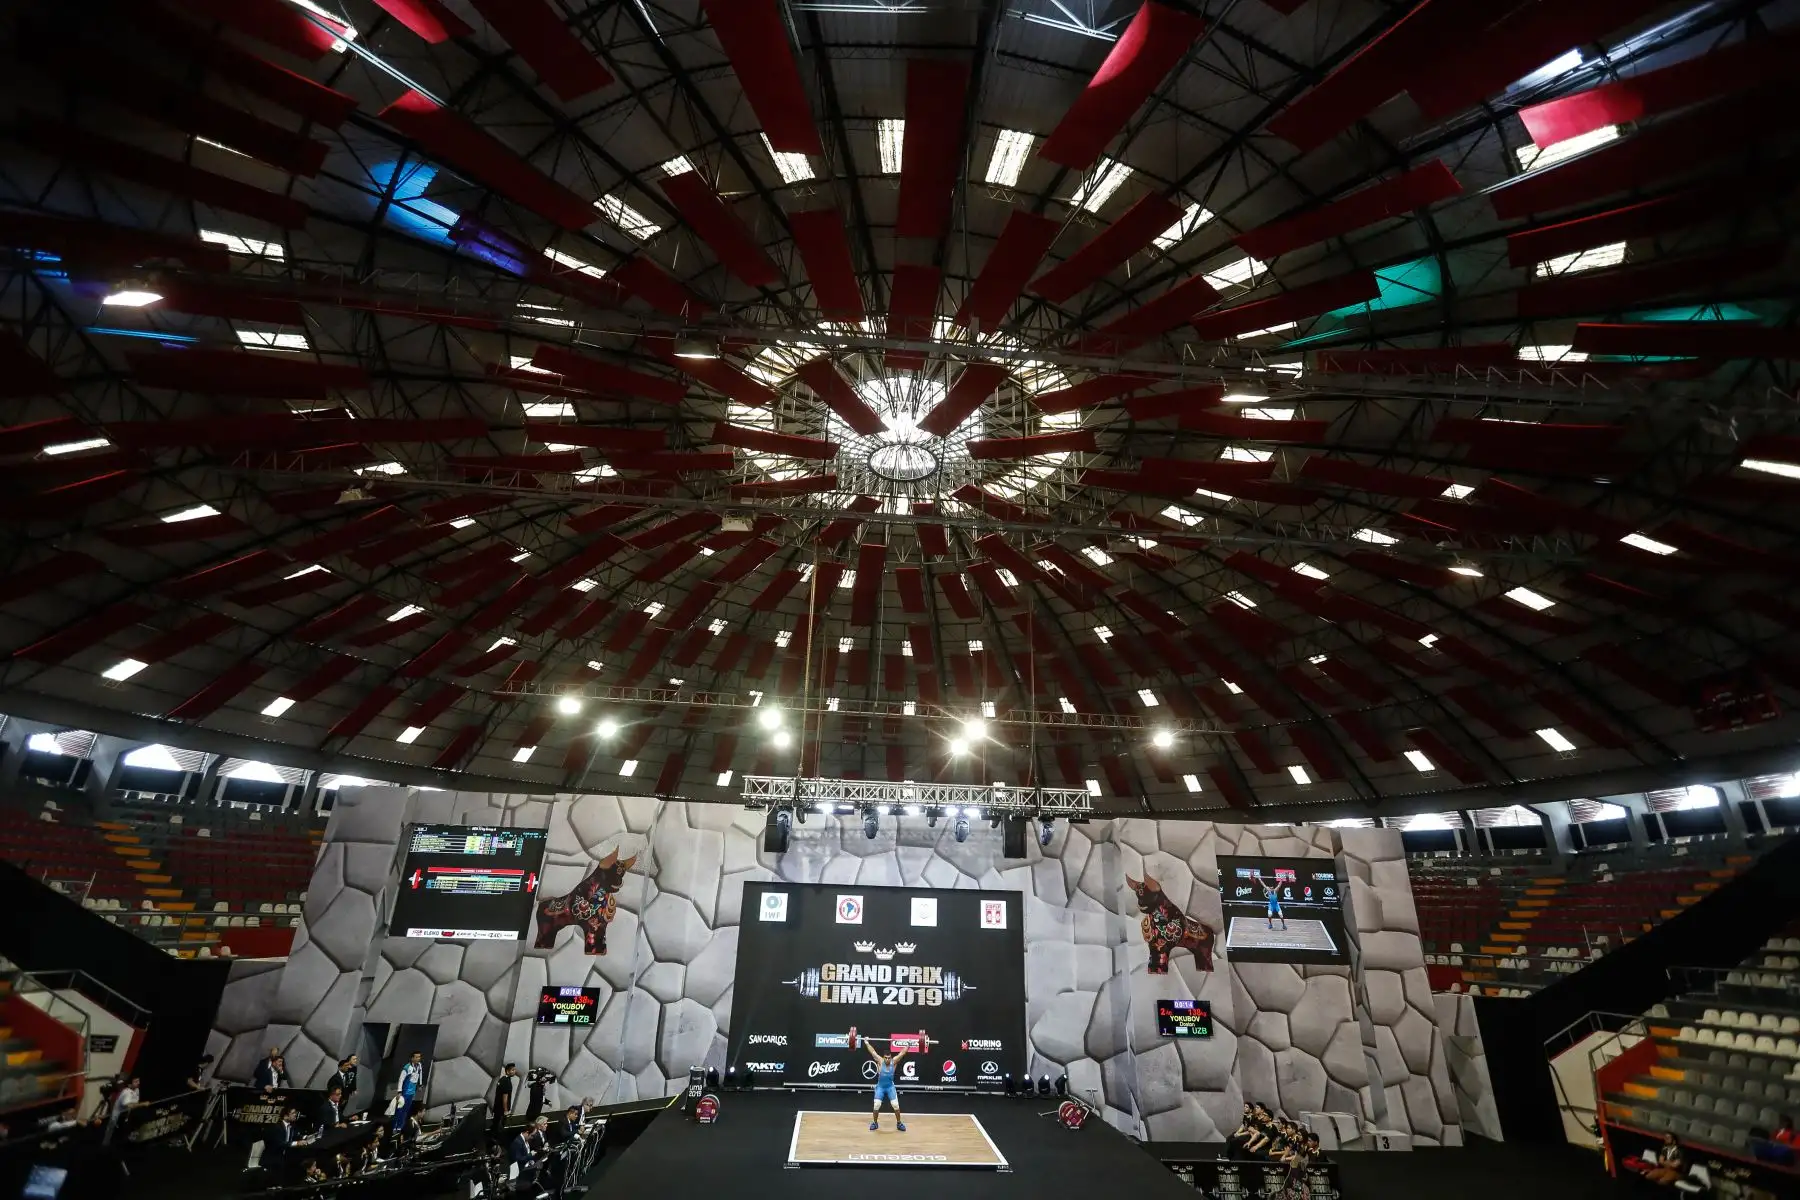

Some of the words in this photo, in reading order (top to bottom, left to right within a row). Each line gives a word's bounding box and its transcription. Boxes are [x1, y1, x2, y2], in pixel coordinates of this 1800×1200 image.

[764, 911, 781, 919] IWF
[820, 963, 892, 983] GRAND
[895, 965, 943, 985] PRIX
[820, 985, 880, 1005] LIMA
[882, 987, 943, 1006] 2019
[573, 1015, 590, 1023] UZB
[1192, 1027, 1208, 1035] UZB
[748, 1034, 762, 1045] SAN
[968, 1039, 1002, 1048] TOURING
[808, 1061, 841, 1077] Oster
[941, 1075, 958, 1083] pepsi
[243, 1105, 273, 1113] GRAND
[240, 1114, 263, 1123] LIMA
[1382, 1136, 1390, 1150] 3
